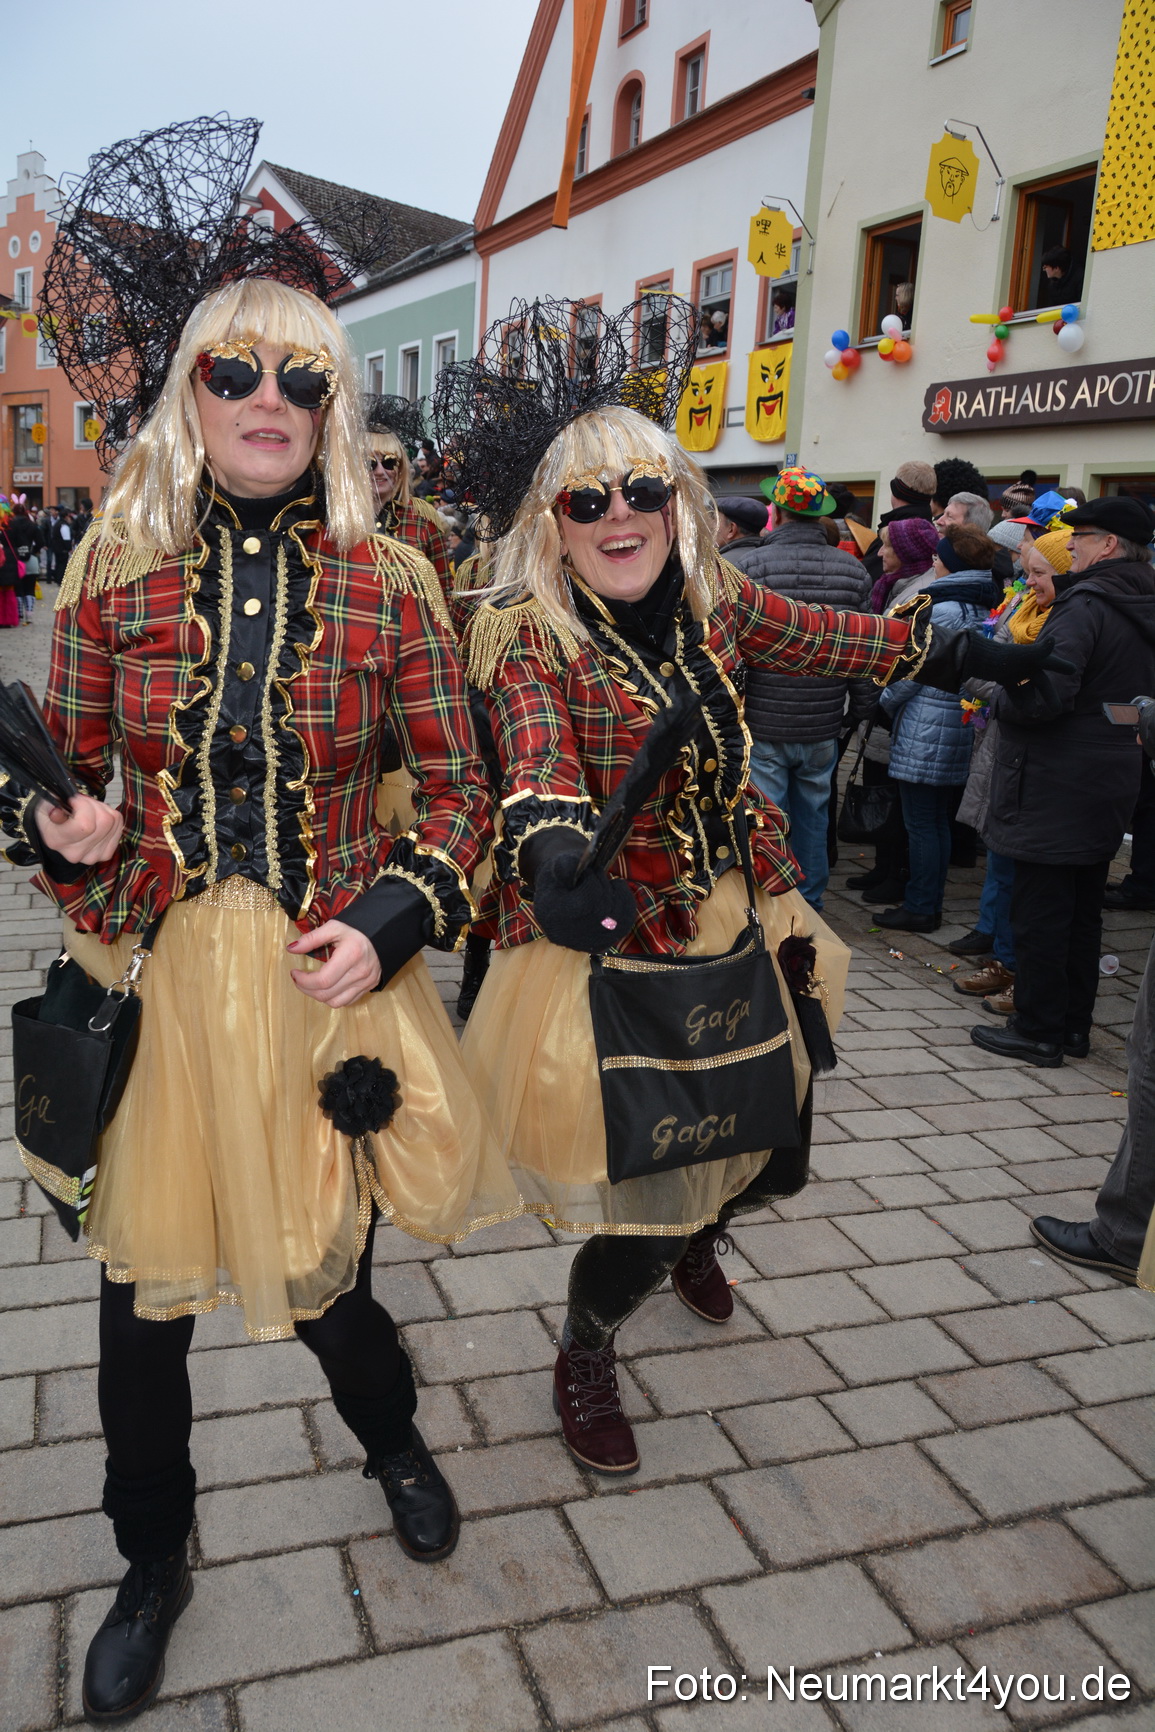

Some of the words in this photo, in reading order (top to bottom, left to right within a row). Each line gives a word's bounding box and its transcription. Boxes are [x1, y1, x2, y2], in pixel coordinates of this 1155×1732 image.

[954, 379, 1068, 420] RATHAUS
[685, 999, 751, 1046] GaGa
[17, 1074, 56, 1137] Ga
[652, 1113, 737, 1160] GaGa
